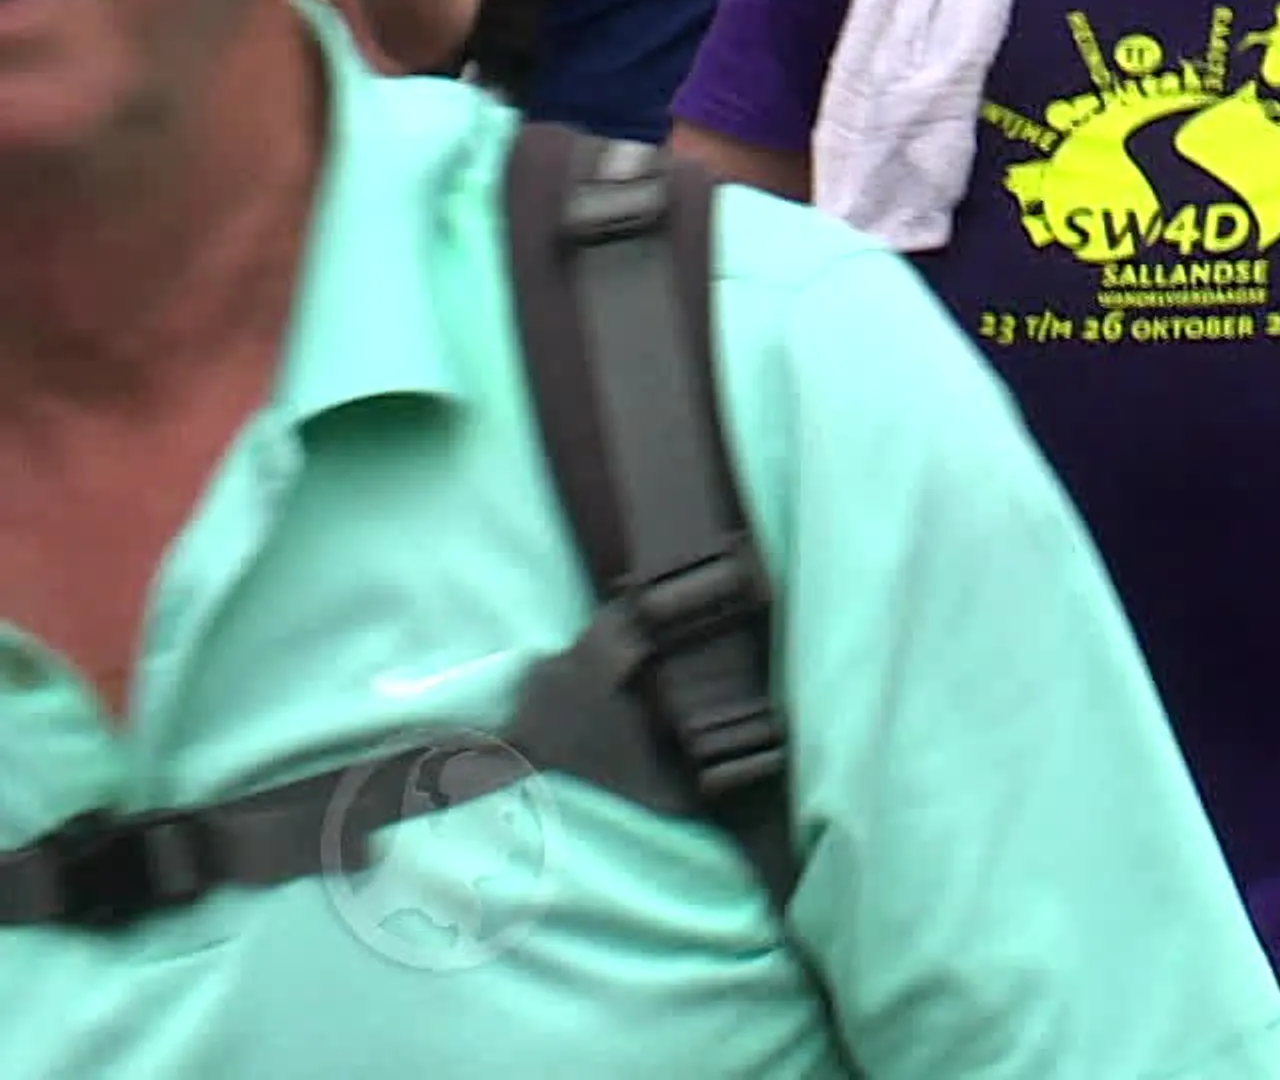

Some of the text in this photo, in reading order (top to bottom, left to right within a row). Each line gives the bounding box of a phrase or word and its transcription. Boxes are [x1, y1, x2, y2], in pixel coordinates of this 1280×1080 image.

[1063, 203, 1251, 256] SW4D
[1102, 260, 1269, 288] SALLANDSE
[979, 311, 1016, 346] 23
[1082, 307, 1125, 343] 26
[1130, 315, 1254, 342] OKTOBER
